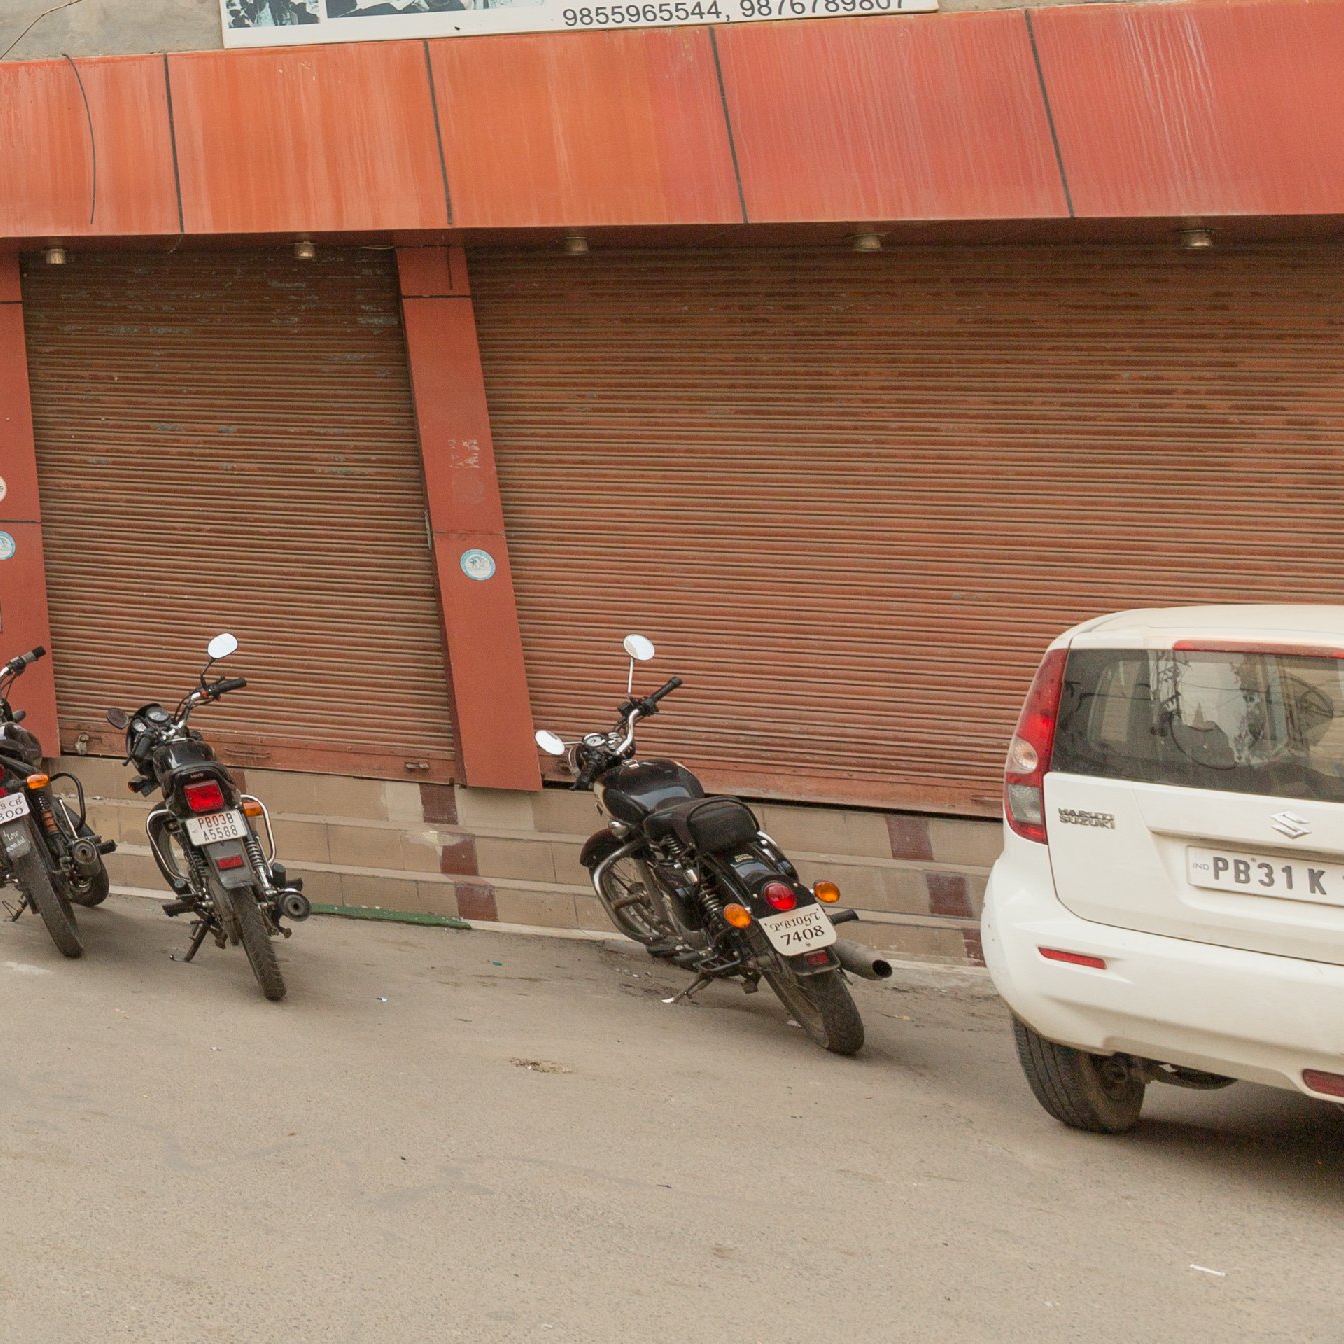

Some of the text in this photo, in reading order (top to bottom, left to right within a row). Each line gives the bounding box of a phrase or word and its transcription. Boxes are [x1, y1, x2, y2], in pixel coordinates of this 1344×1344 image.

[1192, 862, 1209, 870] IND
[1213, 856, 1327, 895] PB31 K
[780, 925, 825, 945] 7408
